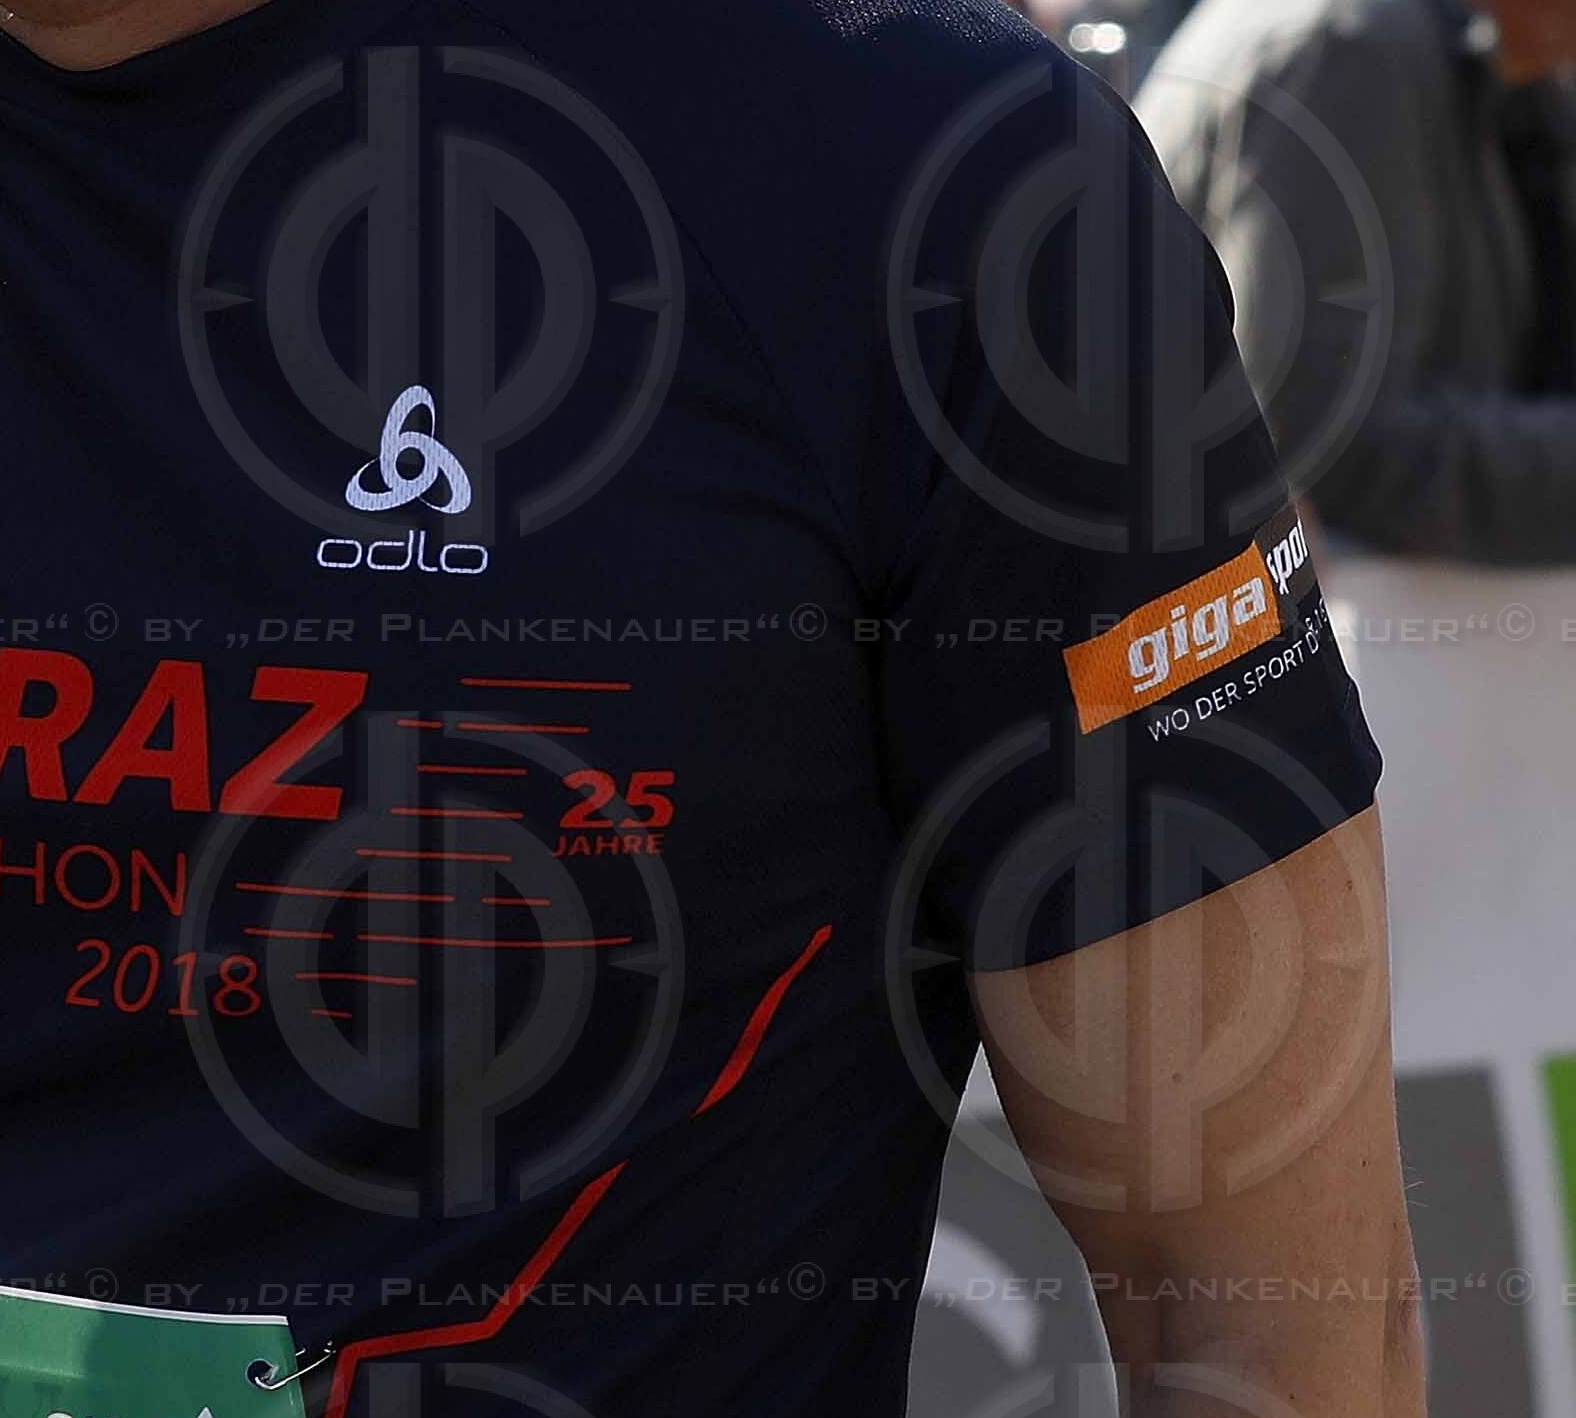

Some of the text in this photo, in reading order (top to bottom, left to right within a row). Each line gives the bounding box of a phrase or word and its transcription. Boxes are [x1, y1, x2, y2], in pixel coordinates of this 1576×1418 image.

[317, 530, 489, 575] odlo
[1147, 708, 1190, 744] WO
[1194, 682, 1239, 722] DER
[1242, 639, 1304, 697] SPORT
[559, 769, 676, 829] 25
[551, 833, 665, 857] JAHRE
[64, 938, 262, 1019] 2018
